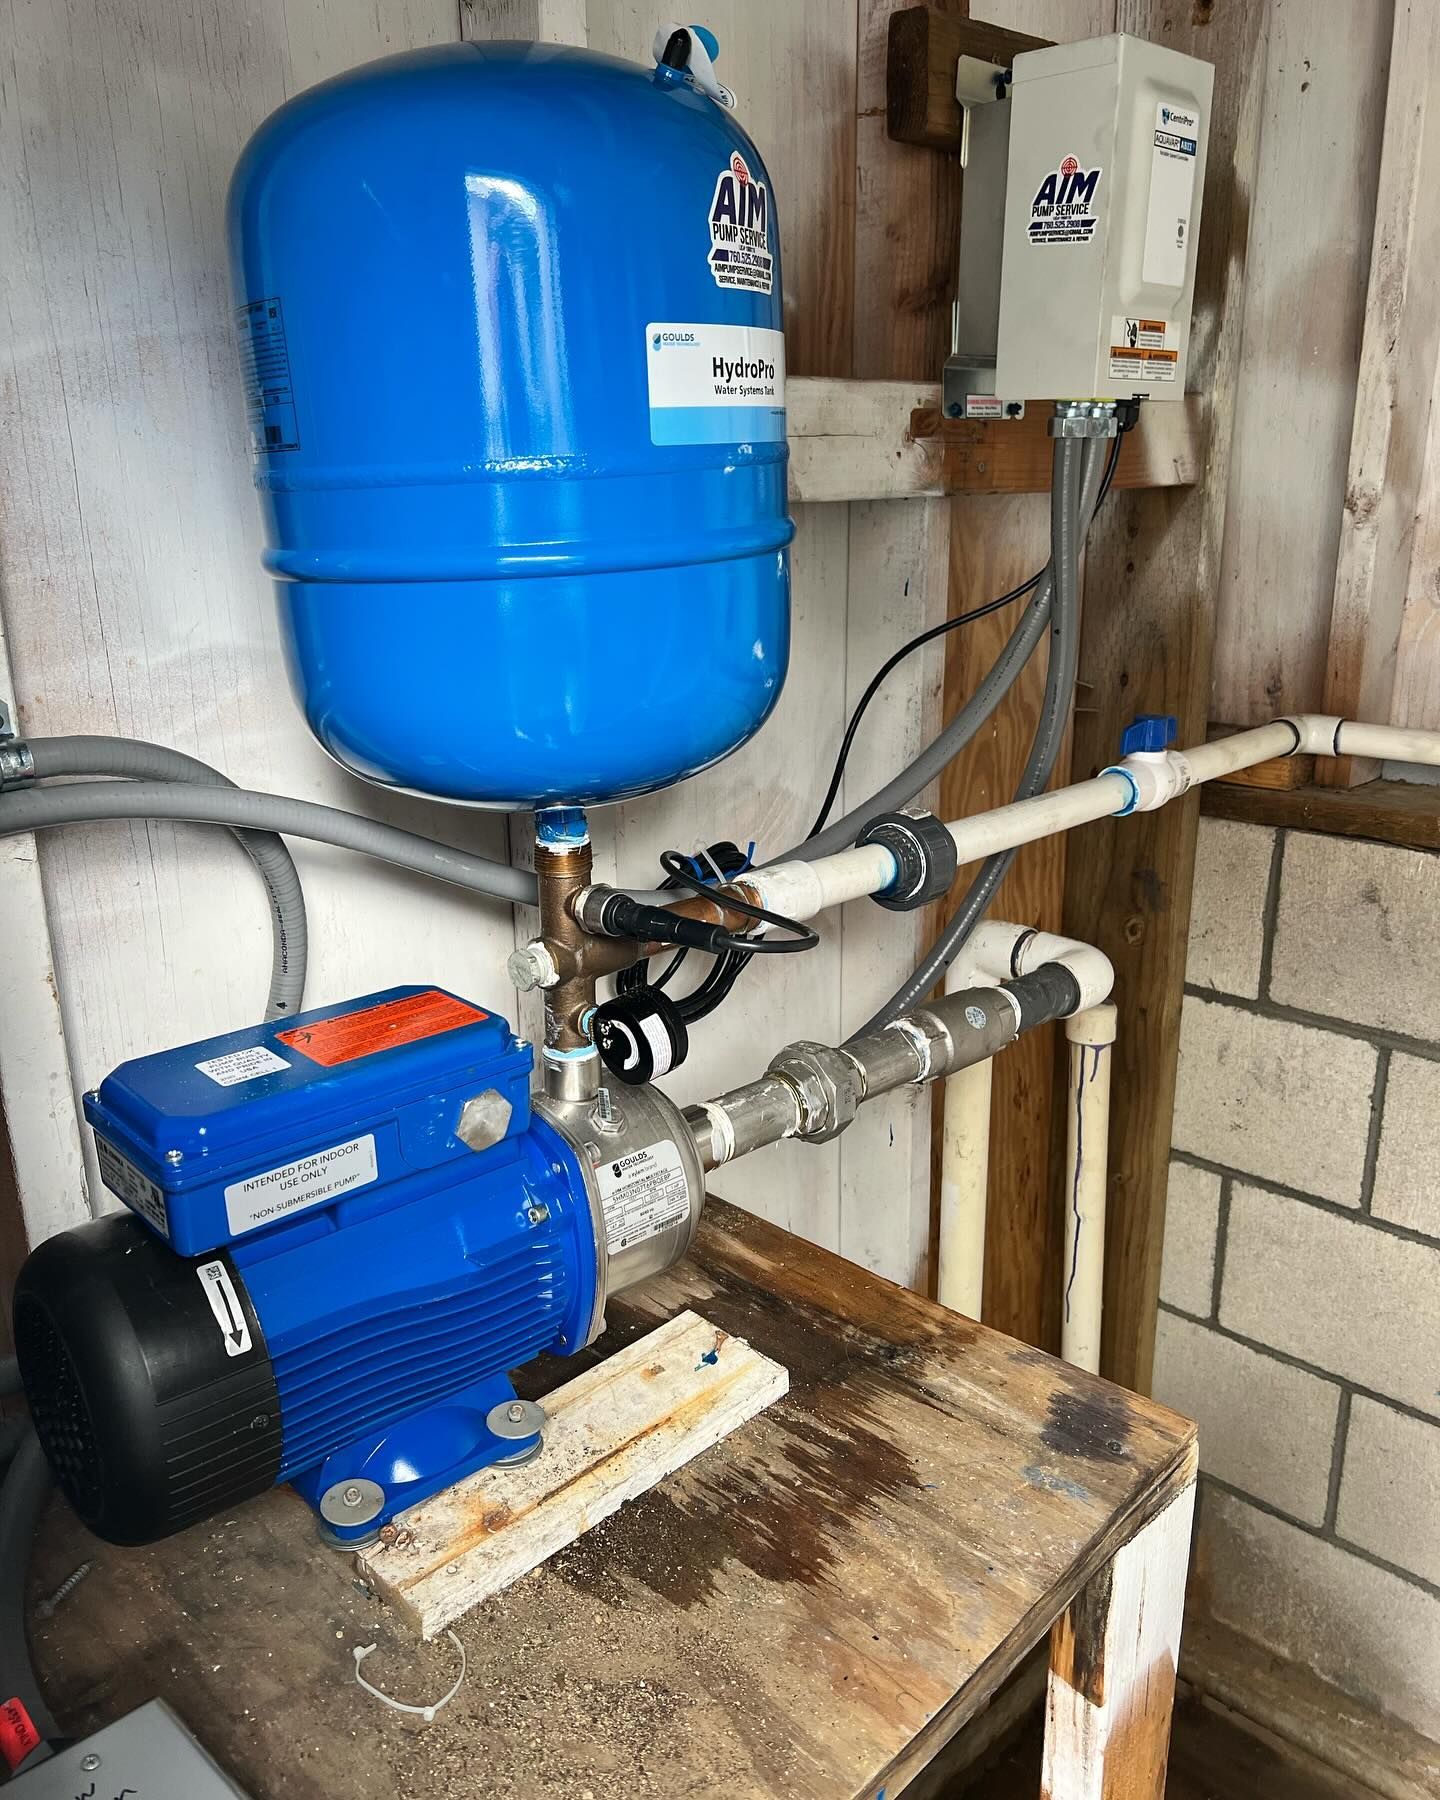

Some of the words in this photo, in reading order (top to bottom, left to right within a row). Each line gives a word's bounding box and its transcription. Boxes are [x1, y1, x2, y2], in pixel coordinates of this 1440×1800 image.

[1033, 170, 1100, 205] AIM
[712, 175, 766, 233] AIM
[1031, 205, 1054, 217] PUMP
[1056, 203, 1090, 216] SERVICE
[713, 222, 738, 243] PUMP
[740, 226, 767, 250] SERVICE
[662, 333, 695, 342] GOULDS
[712, 356, 775, 384] HydroPro
[714, 385, 737, 395] Water
[739, 385, 763, 397] Systems
[764, 386, 774, 395] Tank
[243, 1167, 295, 1193] INTENDED
[297, 1158, 318, 1173] FOR
[319, 1143, 360, 1164] INDOOR
[620, 1151, 648, 1168] GOULDS
[279, 1176, 299, 1191] USE
[301, 1166, 328, 1183] ONLY
